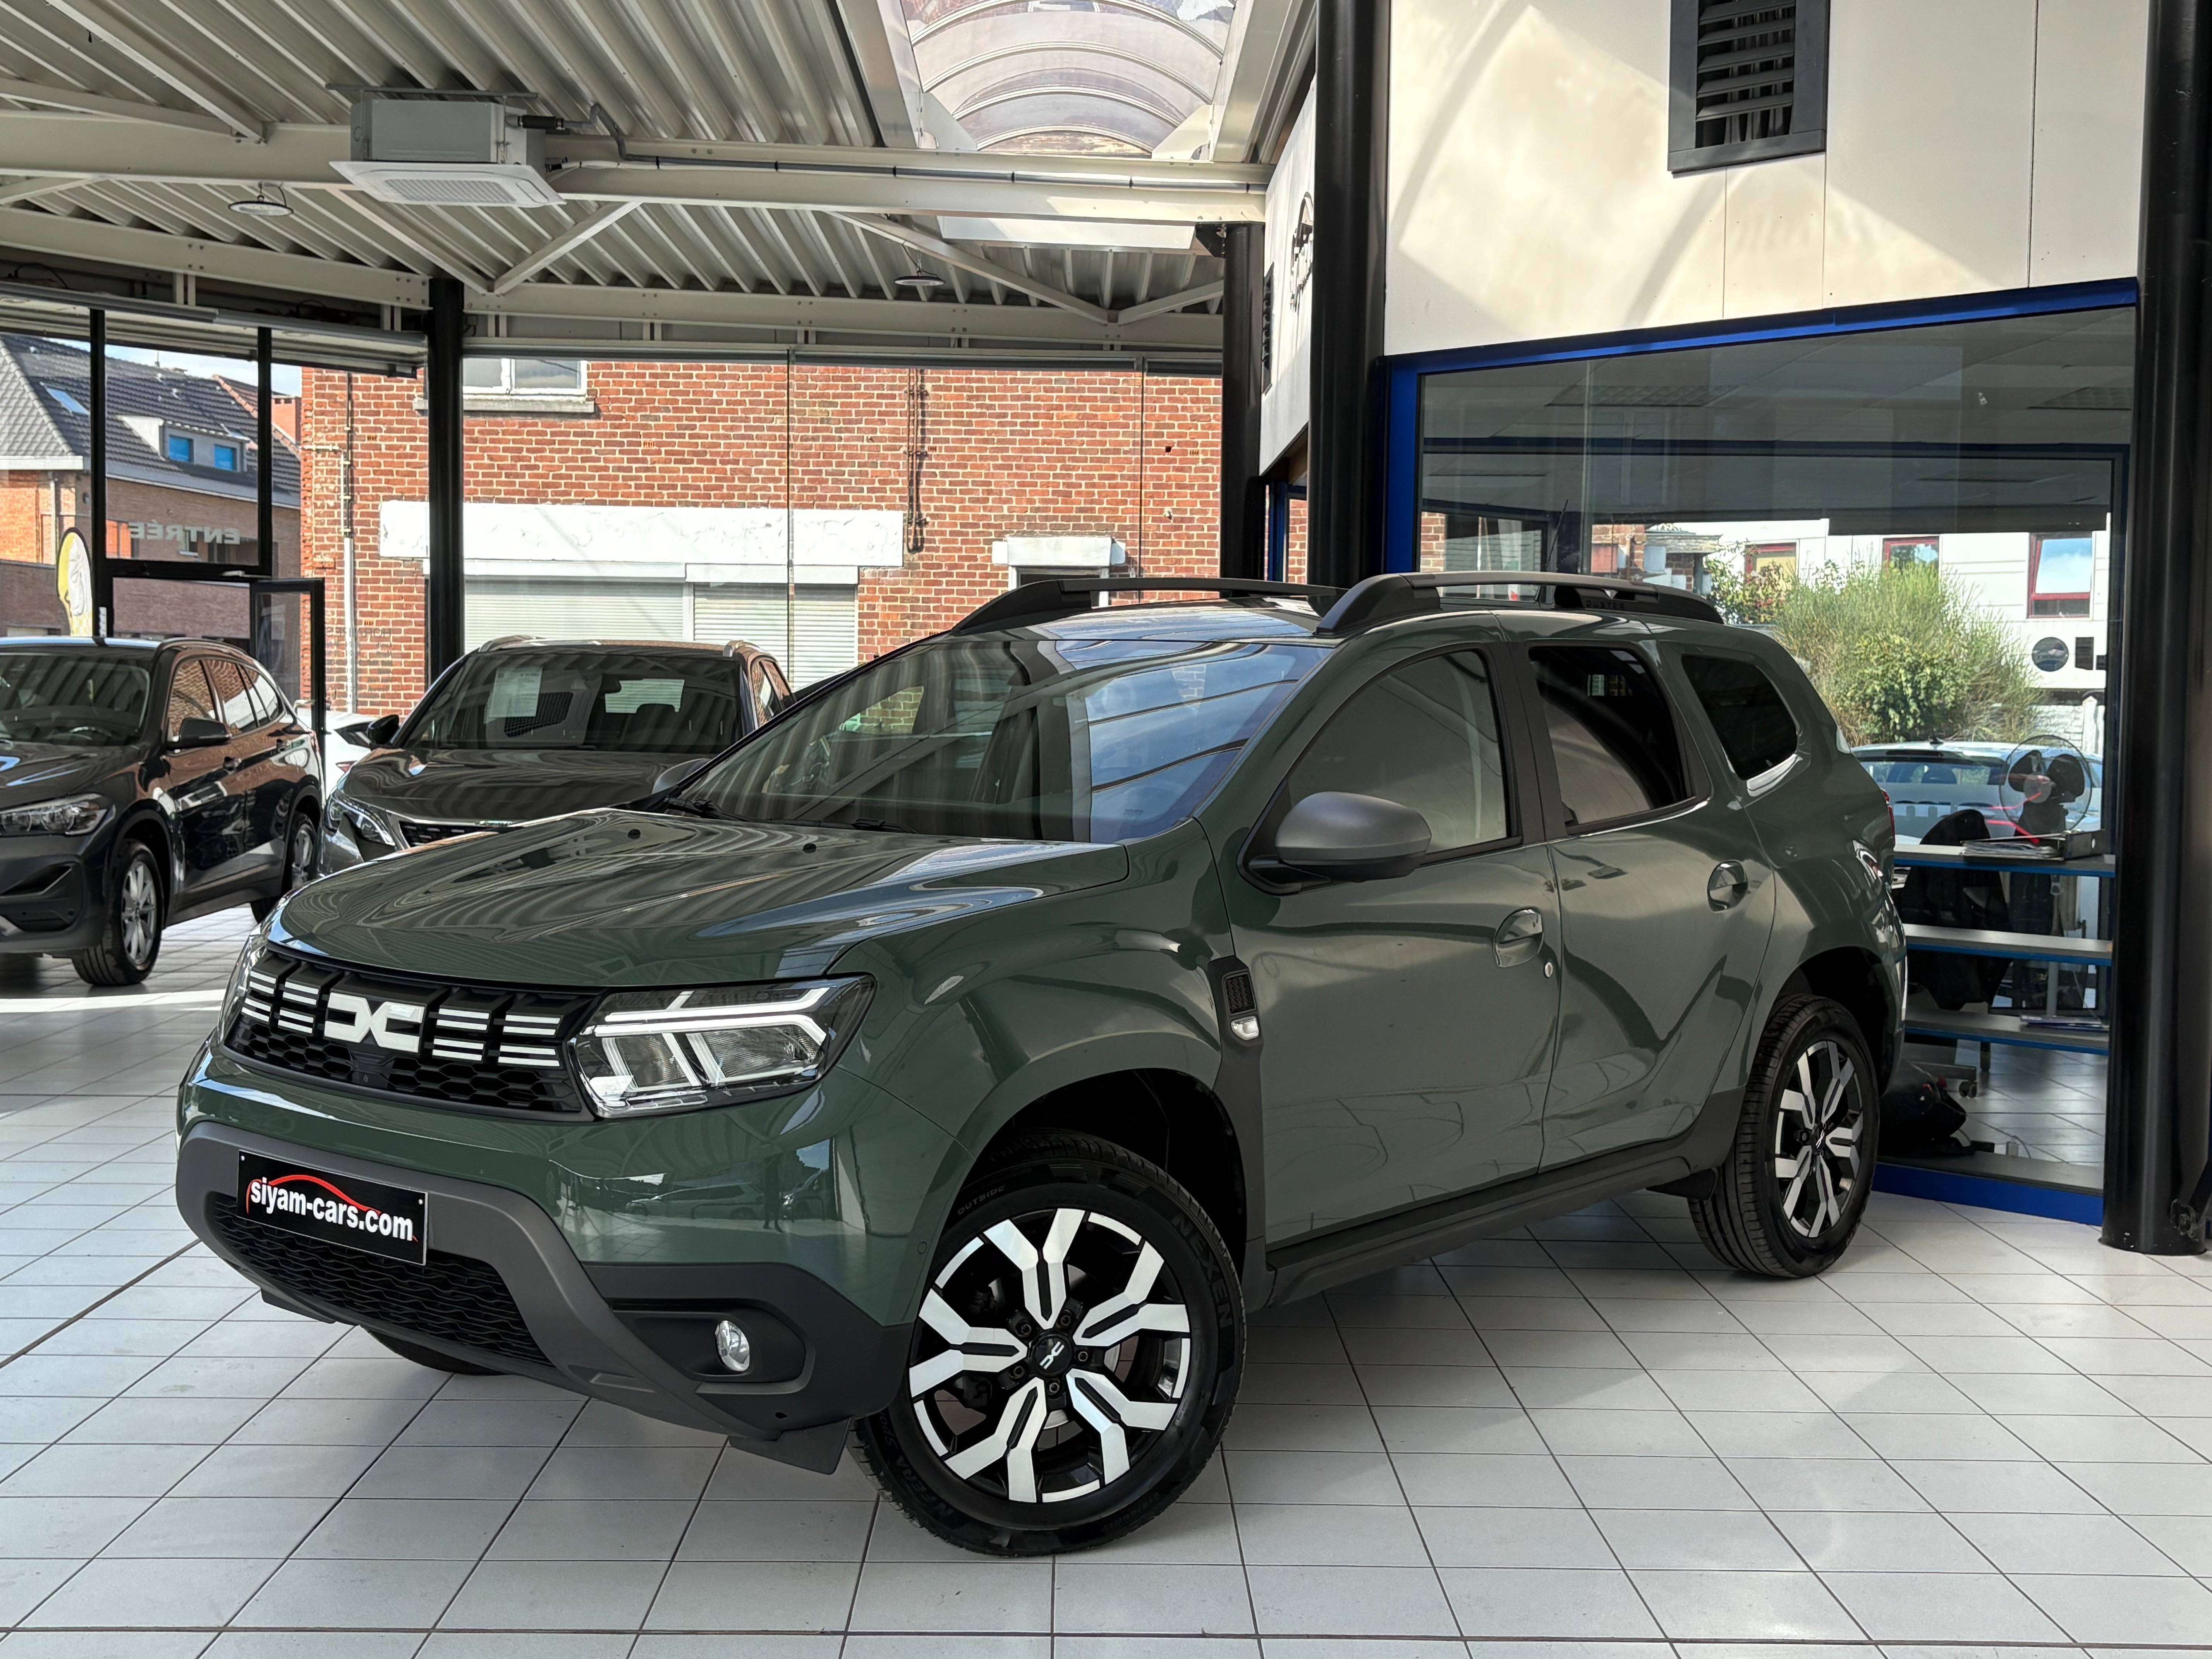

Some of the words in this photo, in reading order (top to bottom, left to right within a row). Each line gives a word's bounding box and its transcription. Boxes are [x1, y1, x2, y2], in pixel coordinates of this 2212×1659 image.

[250, 1177, 413, 1241] siyam-cars.com
[957, 1185, 1006, 1216] OUTSIDE
[1172, 1212, 1233, 1328] NEXEN
